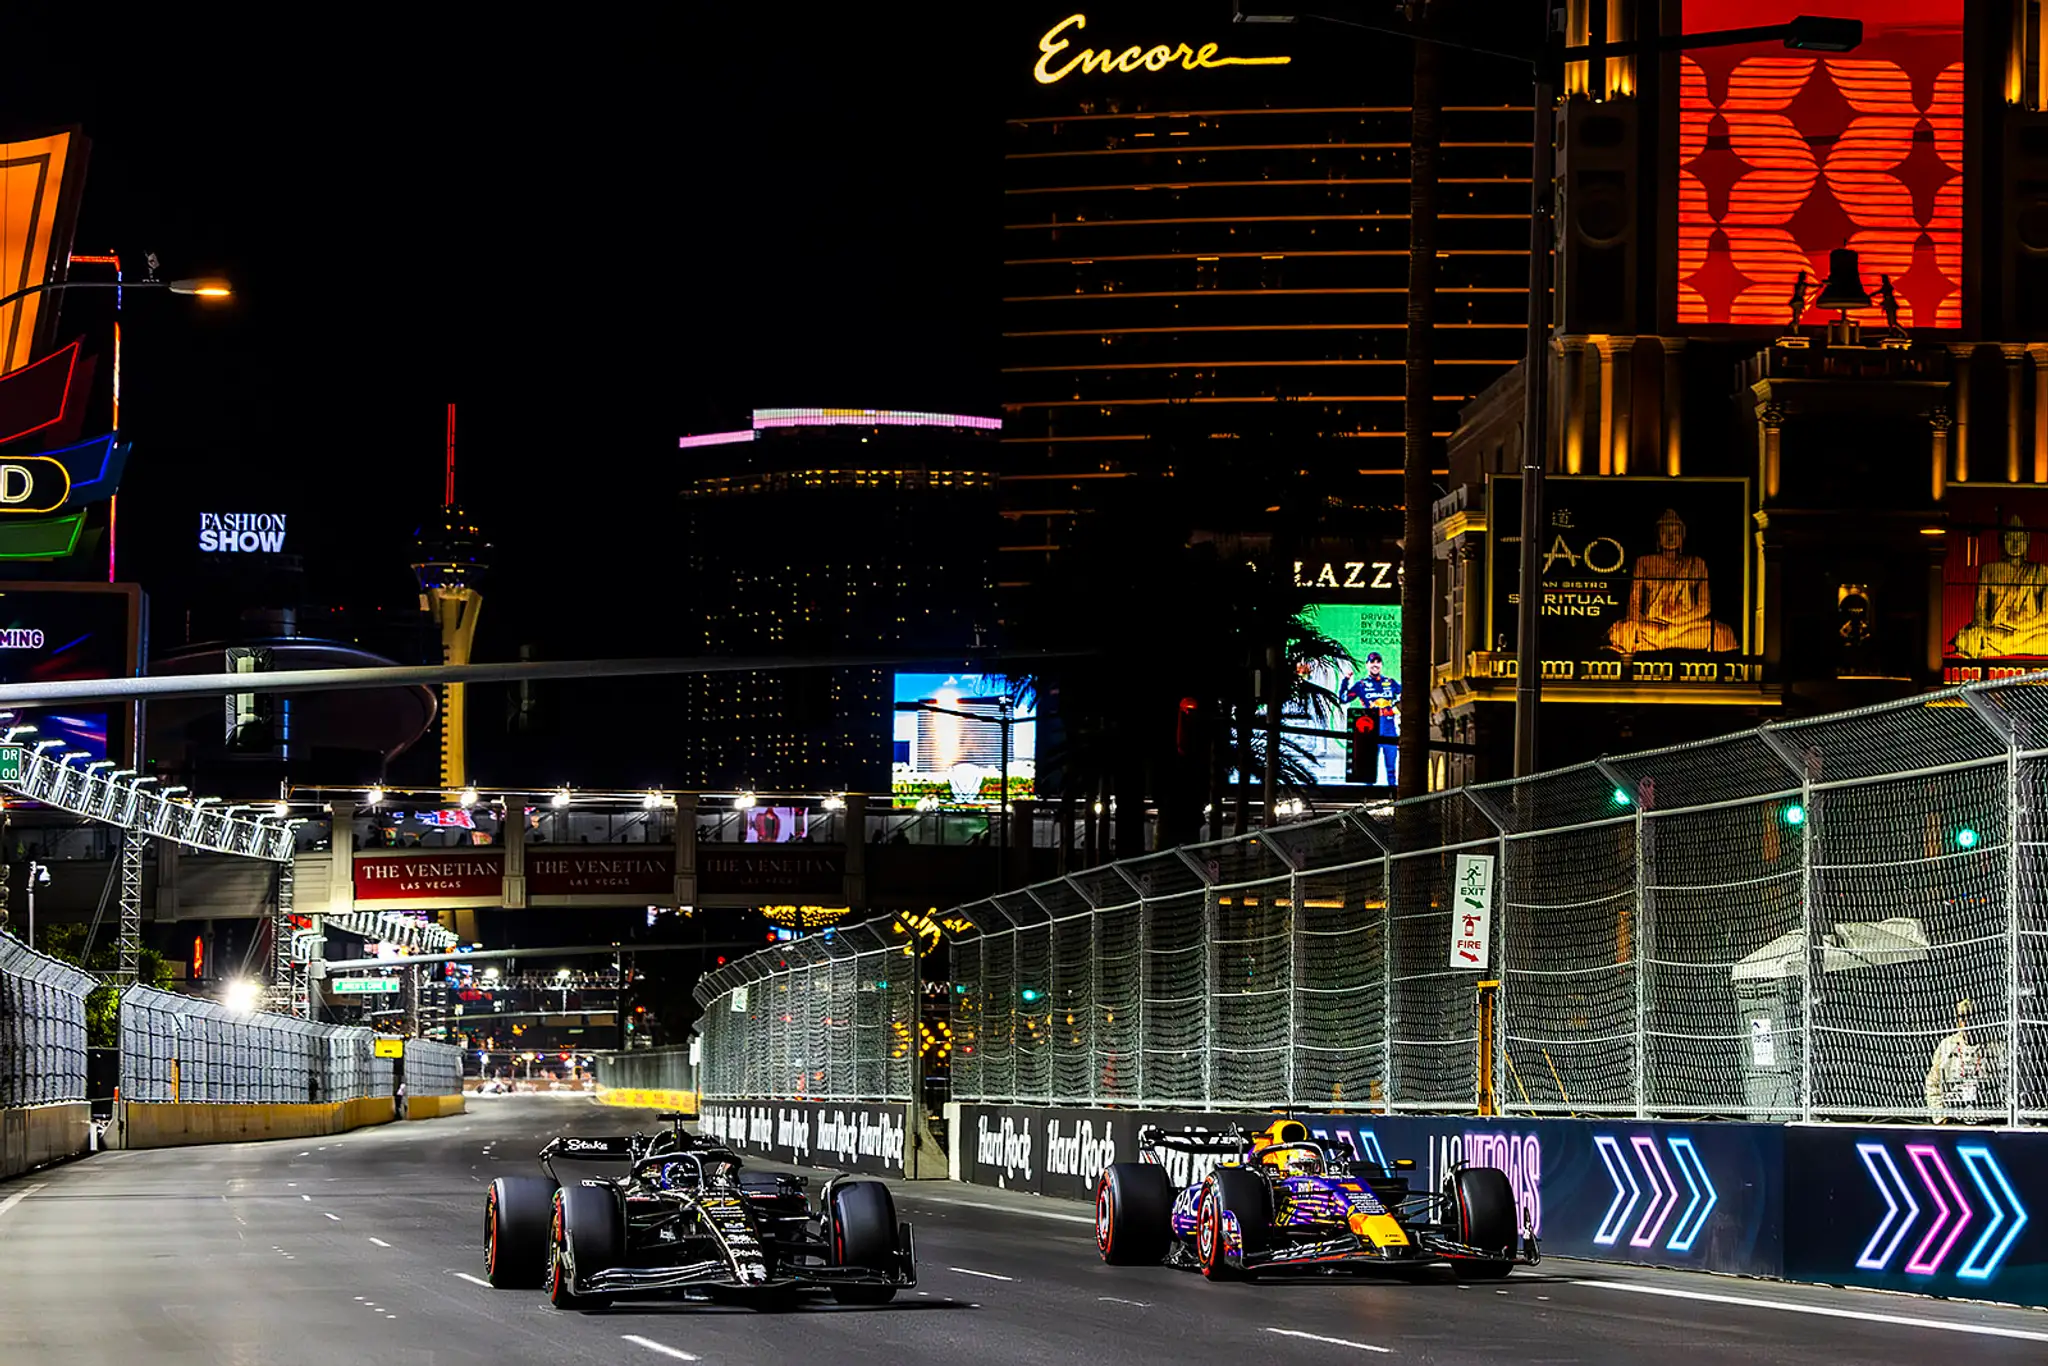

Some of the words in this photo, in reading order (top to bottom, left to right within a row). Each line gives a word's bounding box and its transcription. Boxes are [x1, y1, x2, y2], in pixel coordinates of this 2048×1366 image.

[1034, 14, 1291, 84] Encore
[0, 465, 33, 503] D
[200, 512, 286, 531] FASHION
[199, 530, 286, 552] SHOW
[1292, 561, 1404, 588] LAZZ
[1508, 593, 1619, 605] SRITUAL
[1361, 613, 1395, 621] DRIVEN
[1541, 605, 1601, 616] INING
[2, 750, 18, 760] DR
[2, 768, 18, 779] 00
[362, 865, 400, 879] THE
[405, 862, 498, 877] VENETIAN
[534, 861, 569, 874] THE
[575, 860, 667, 874] VENETIAN
[400, 882, 420, 890] LAS
[425, 880, 462, 889] VEGAS
[1460, 887, 1486, 896] EXIT
[1457, 940, 1482, 949] FIRE
[567, 1139, 608, 1151] Stake
[977, 1115, 1004, 1166] Hard
[1003, 1117, 1032, 1180] Rock
[1047, 1119, 1082, 1176] Hard
